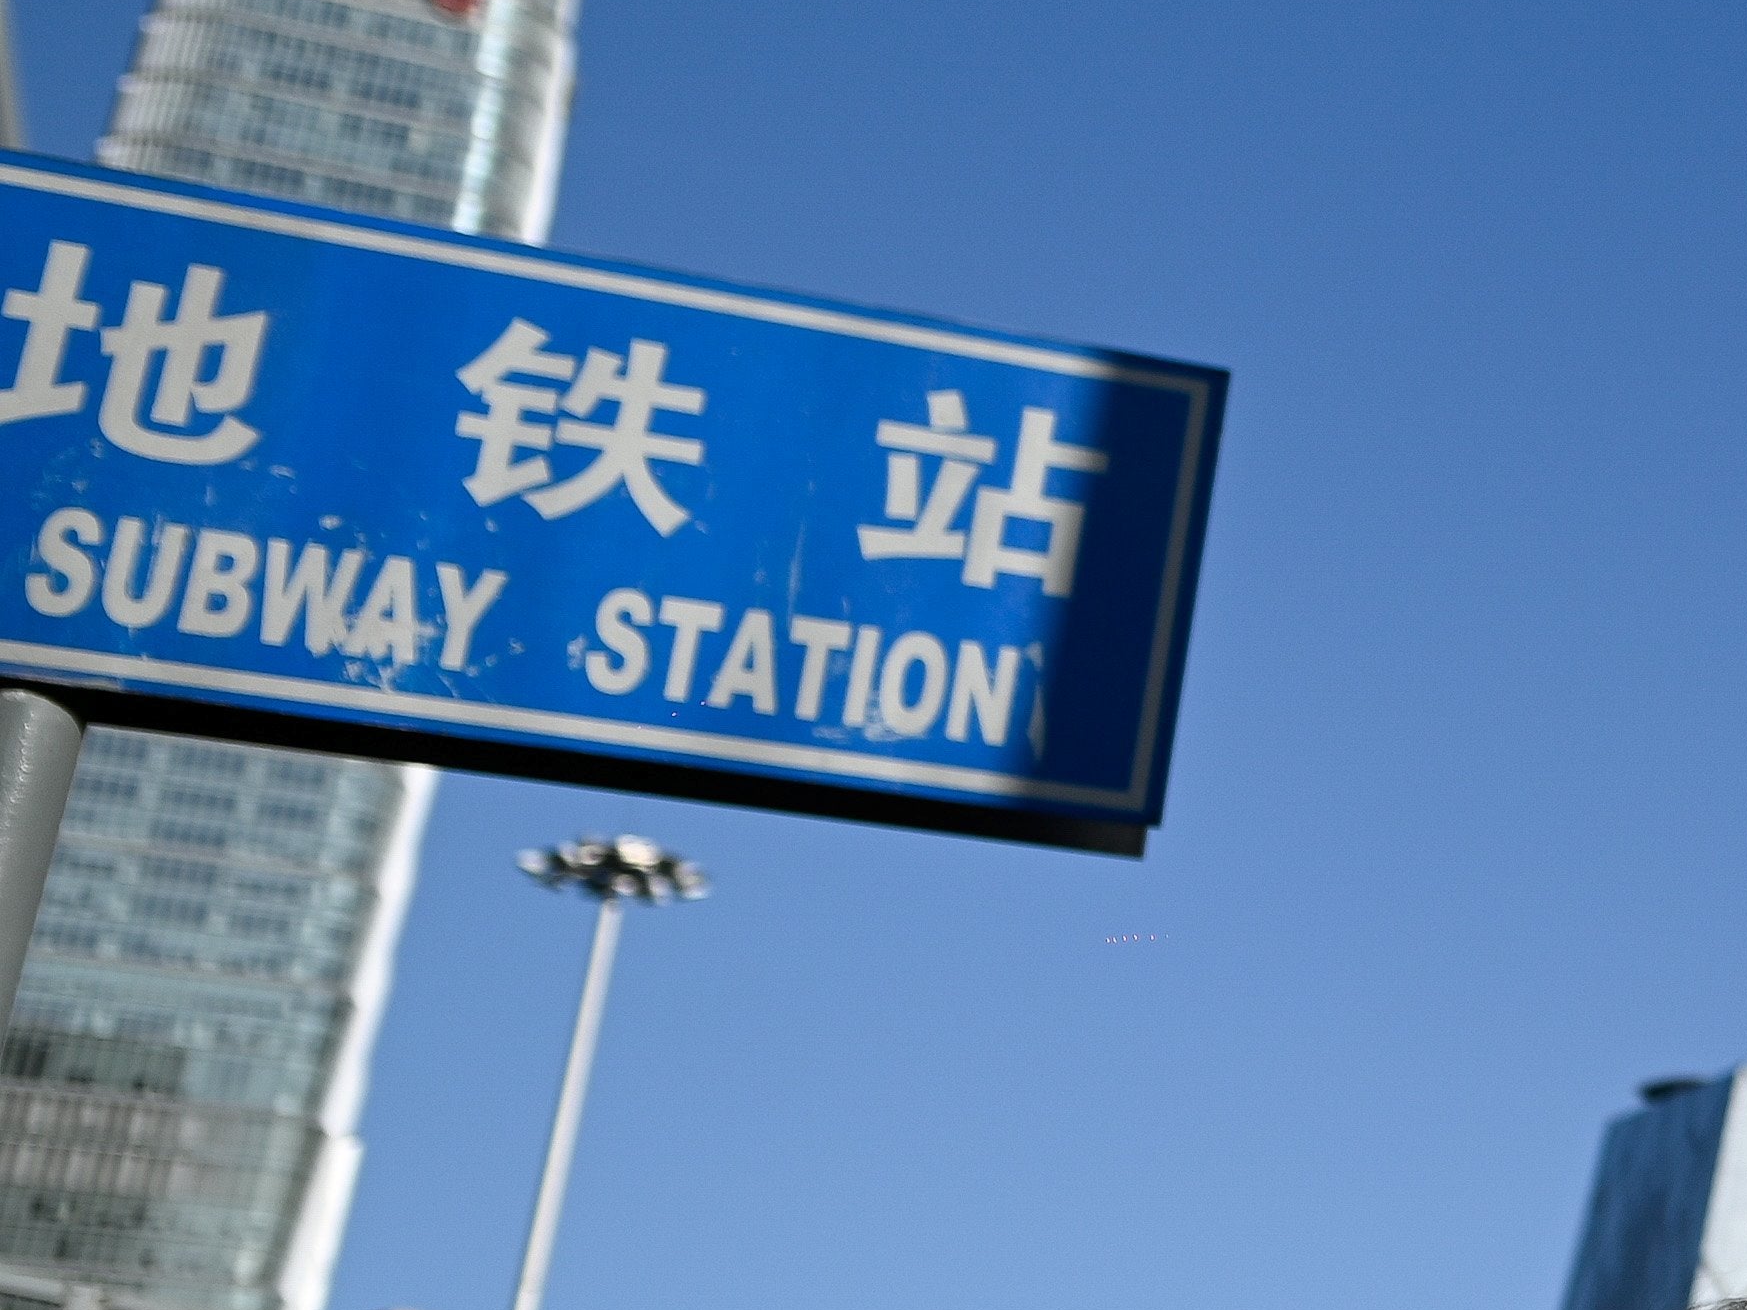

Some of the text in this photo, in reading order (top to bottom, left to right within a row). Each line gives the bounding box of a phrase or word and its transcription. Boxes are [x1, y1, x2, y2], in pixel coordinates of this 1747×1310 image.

[0, 240, 1109, 597] 地铁站
[24, 508, 1022, 748] SUBWAY STATION
